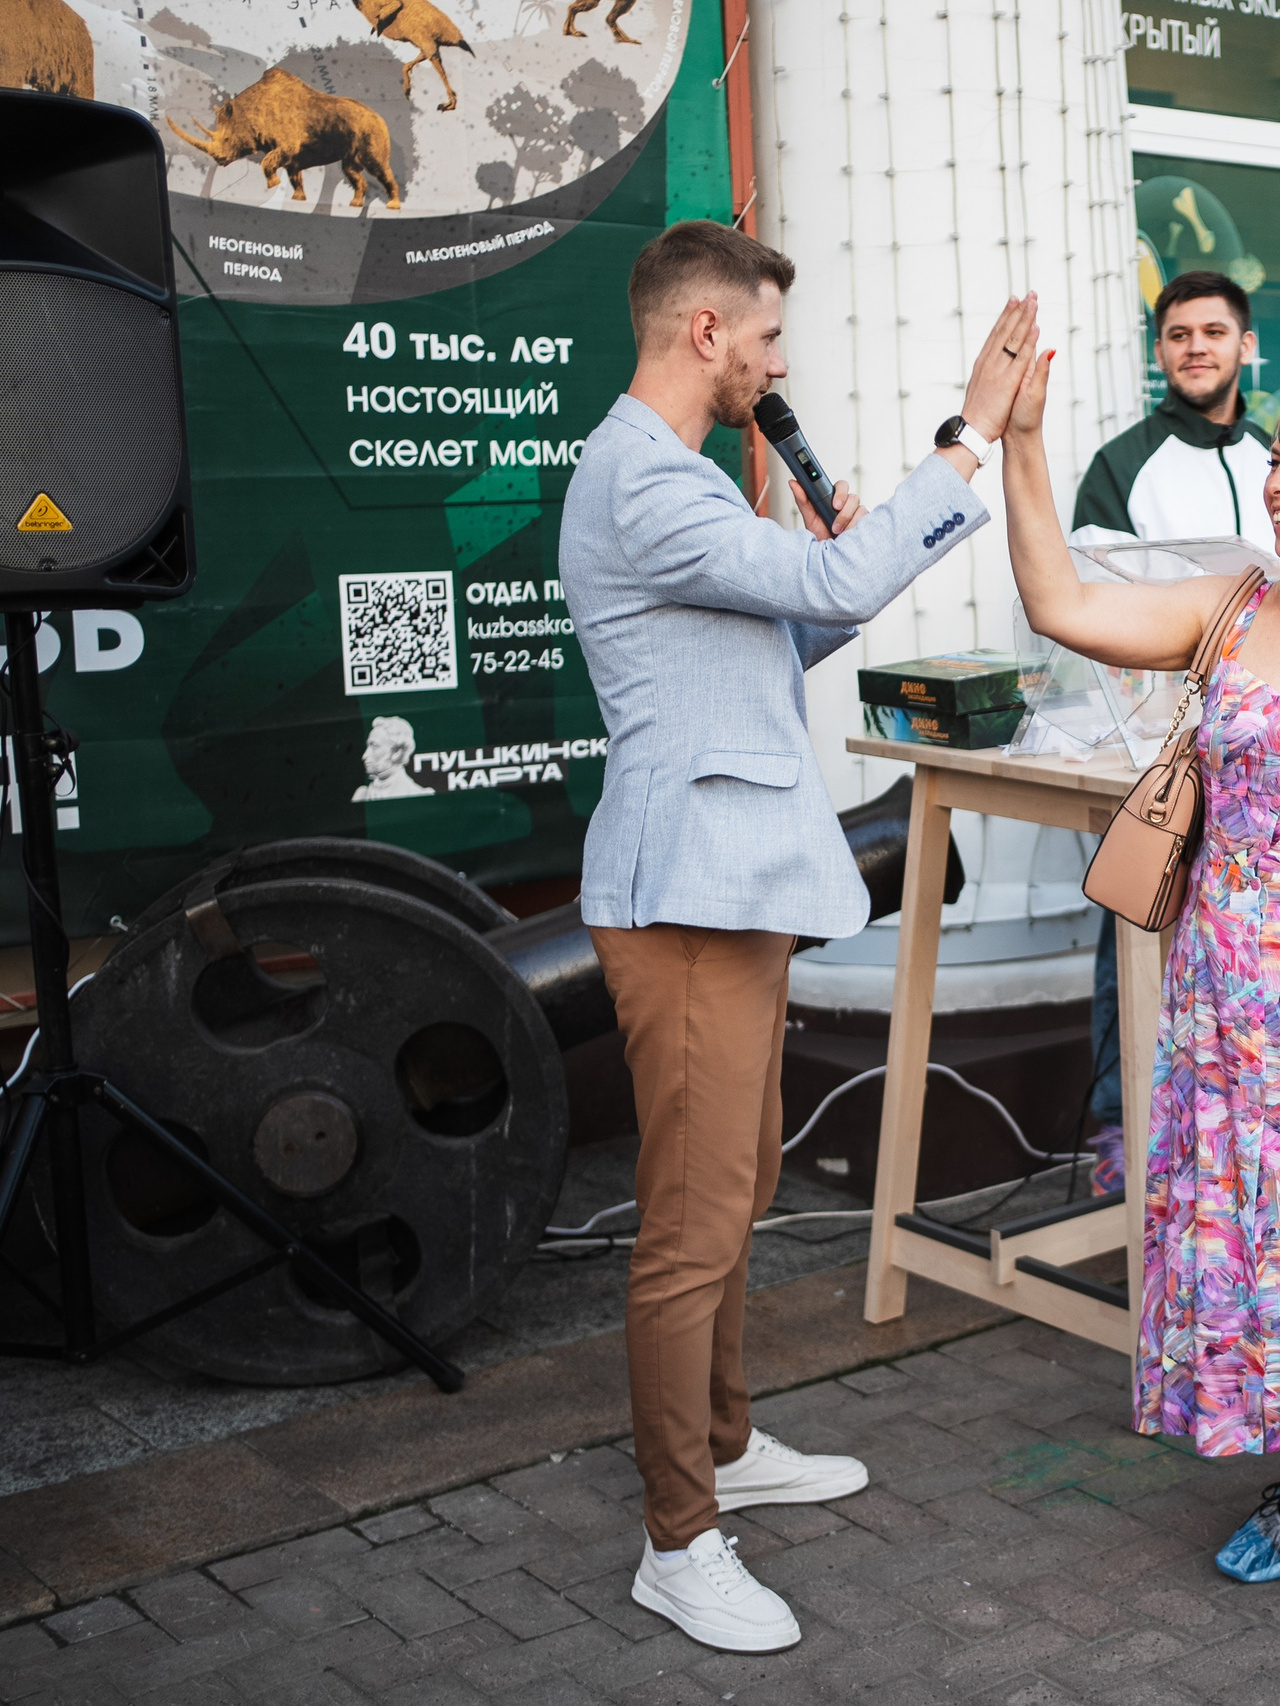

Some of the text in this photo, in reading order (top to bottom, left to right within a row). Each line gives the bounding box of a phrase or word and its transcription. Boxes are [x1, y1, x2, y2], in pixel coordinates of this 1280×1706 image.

[208, 235, 304, 260] НЕОГЕНОВЫЙ
[405, 220, 555, 264] ПАЛЕОГЕНОВЫЙ ПЕРИОД
[223, 261, 283, 283] ПЕРИОД
[342, 321, 574, 364] 40 тыс. лет
[346, 381, 560, 419] настоящий
[349, 439, 479, 467] скелет
[25, 520, 63, 529] behringer
[465, 579, 566, 607] ОТДЕЛ П
[467, 613, 575, 640] kuzbasskra
[470, 647, 565, 675] 75-22-45
[900, 681, 926, 695] ДИНО
[911, 717, 939, 731] ДИНО
[413, 737, 609, 772] ПУШКИНСК
[447, 762, 563, 791] КАРТА
